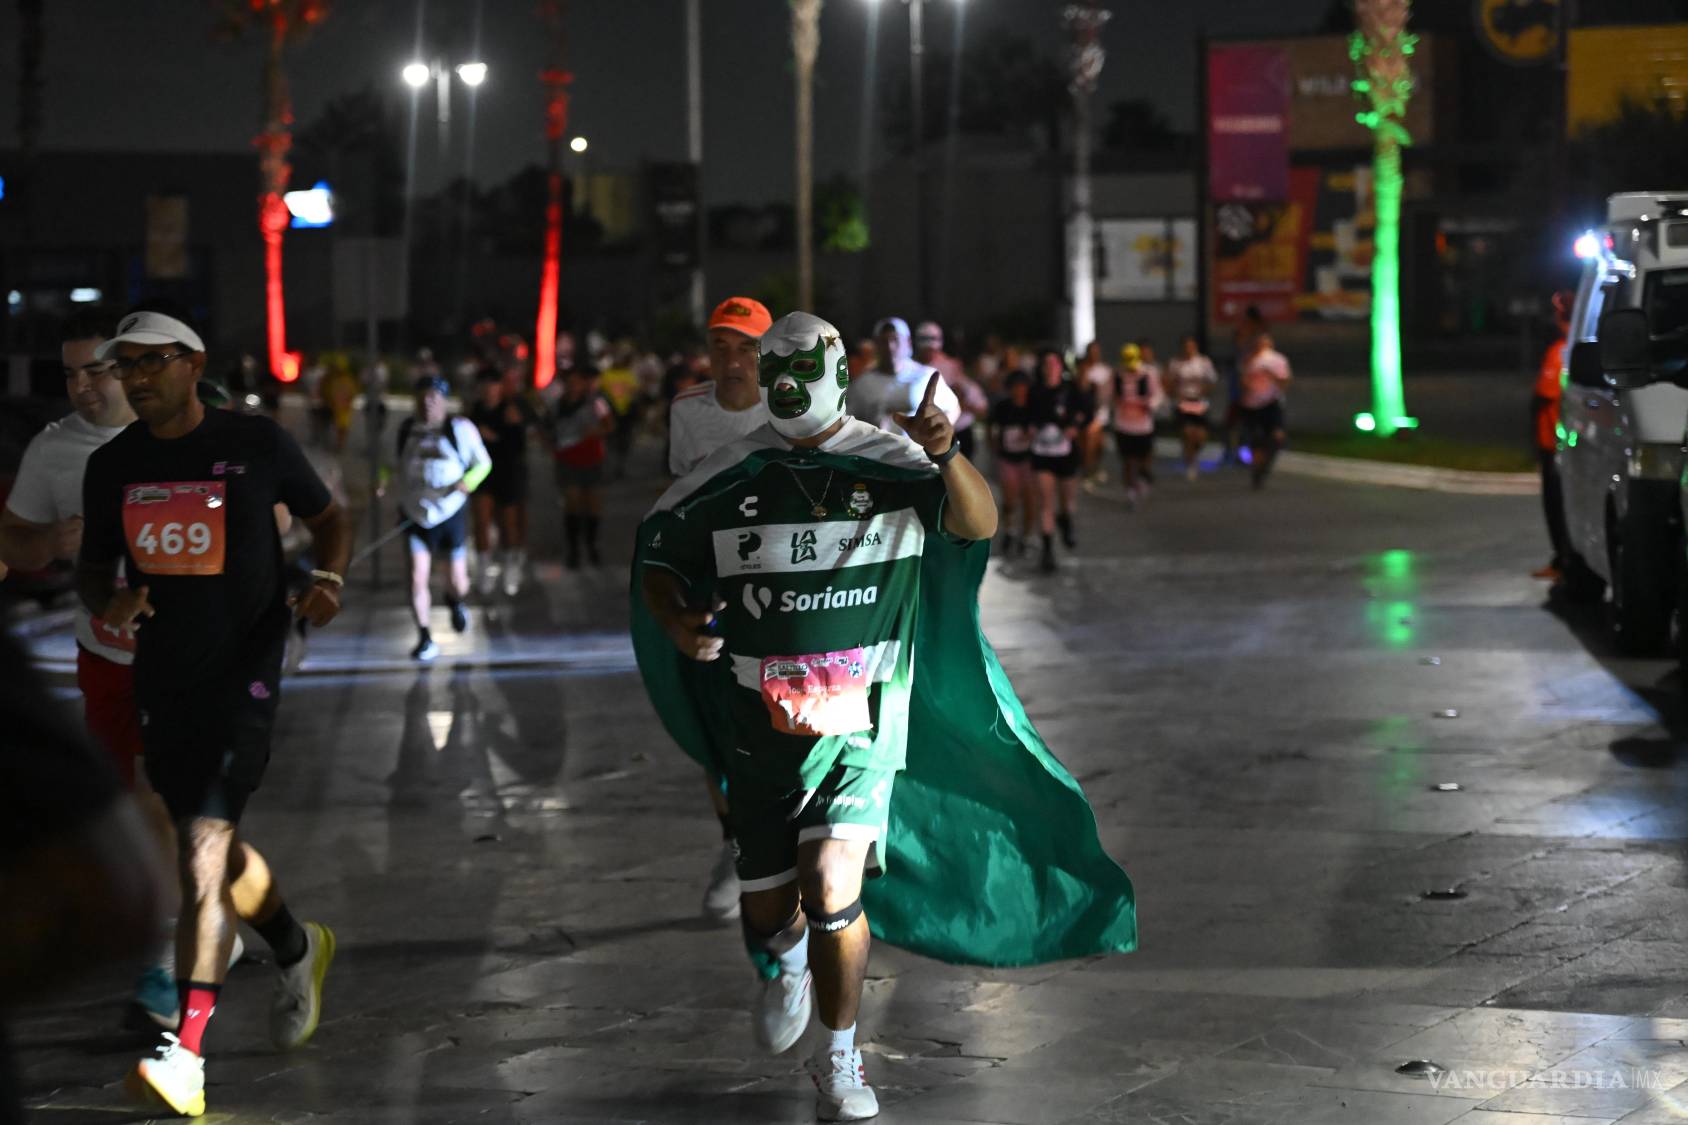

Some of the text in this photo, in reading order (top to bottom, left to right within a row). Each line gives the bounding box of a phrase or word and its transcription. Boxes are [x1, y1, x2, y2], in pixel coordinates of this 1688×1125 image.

[136, 522, 212, 555] 469
[838, 532, 882, 551] SIMSA
[780, 585, 878, 612] Soriana
